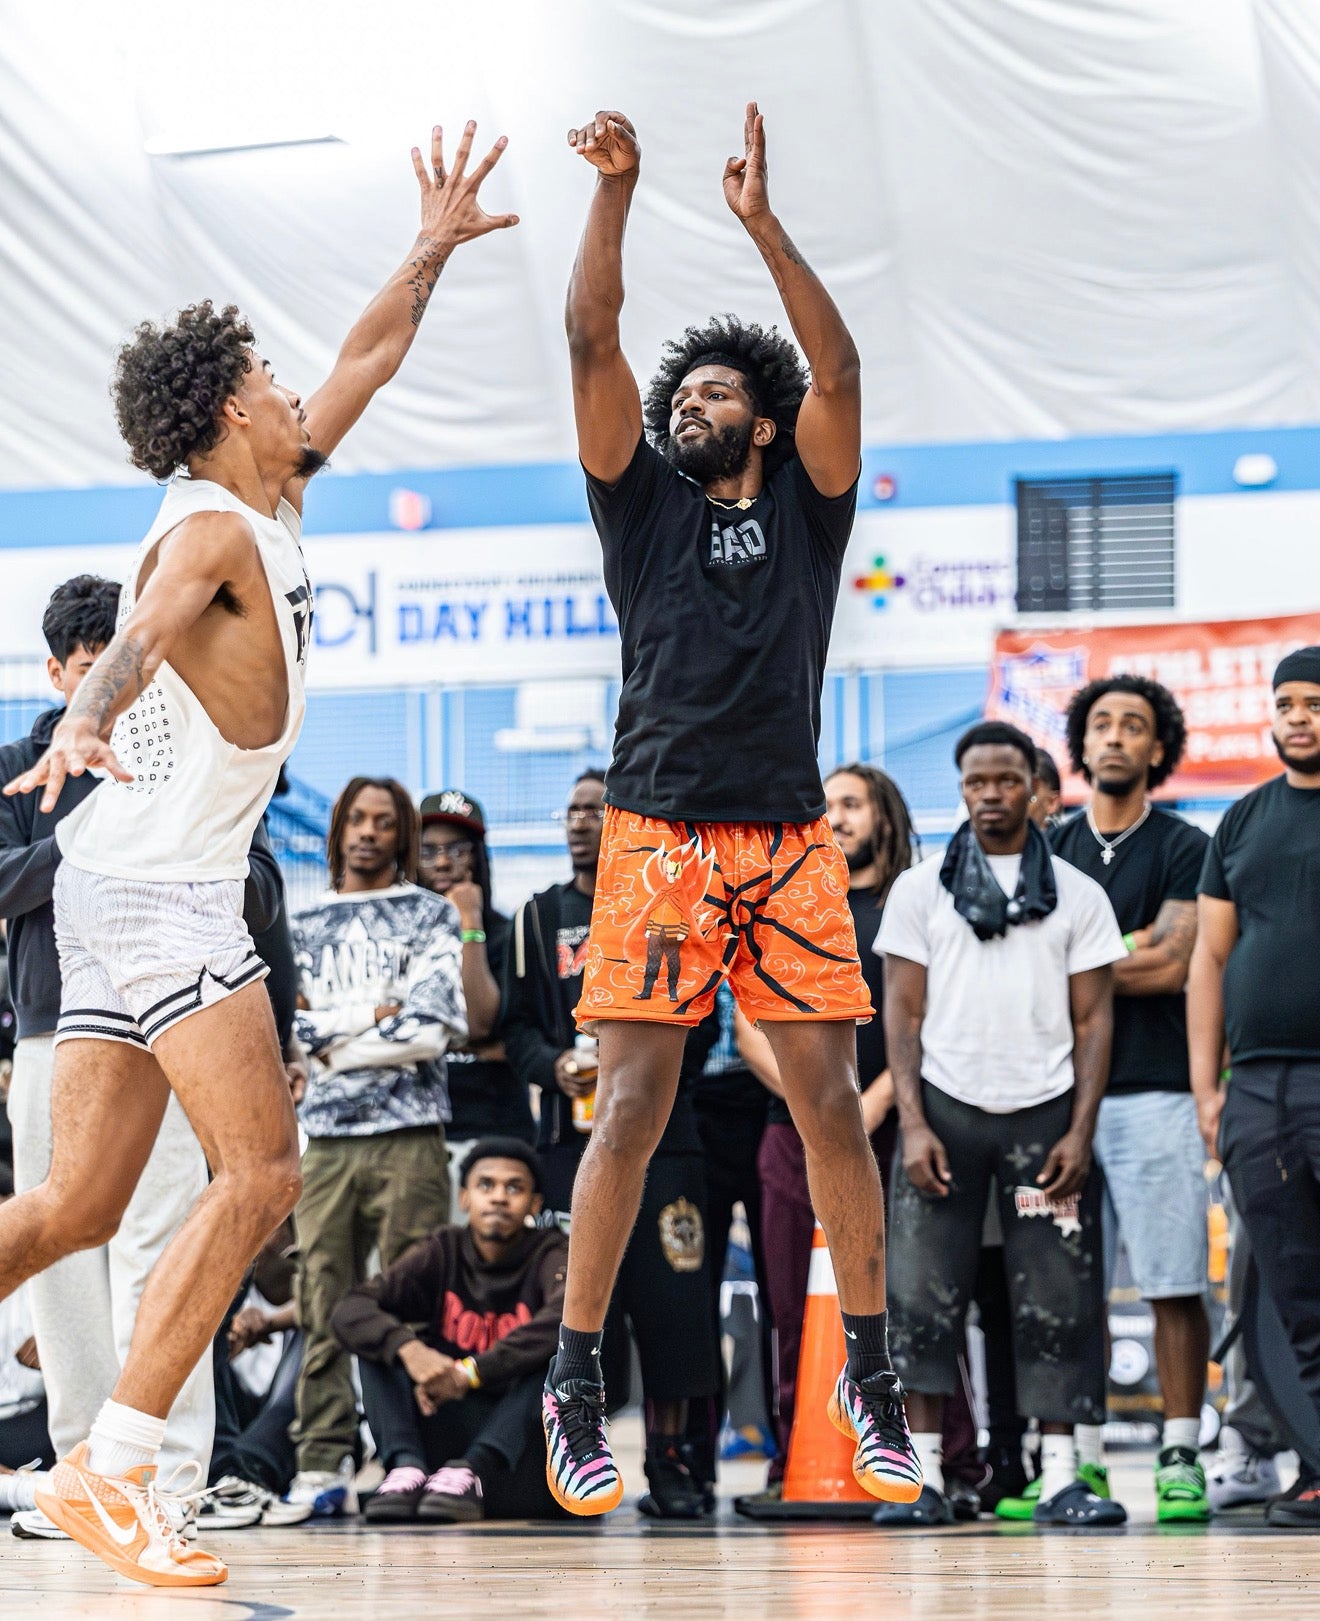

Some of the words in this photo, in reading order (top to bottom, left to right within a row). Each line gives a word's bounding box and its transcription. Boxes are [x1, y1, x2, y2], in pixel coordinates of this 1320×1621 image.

[398, 601, 486, 644] DAY
[504, 594, 619, 640] HILL
[140, 688, 164, 703] DDS
[128, 703, 167, 721] ODDS
[130, 718, 170, 735] ODDS
